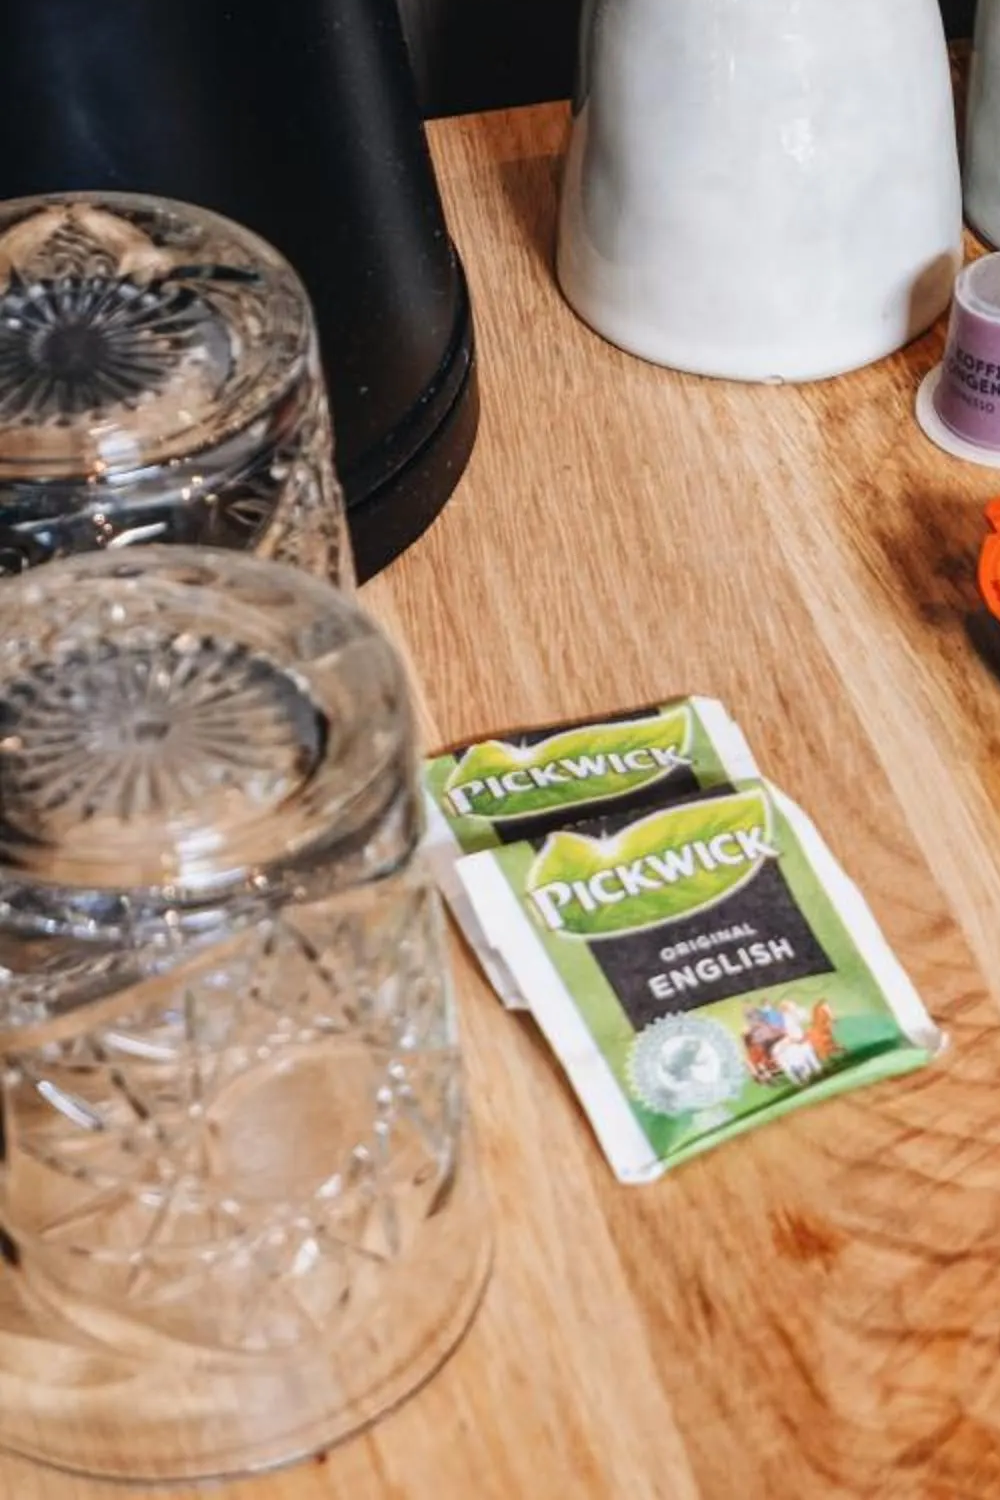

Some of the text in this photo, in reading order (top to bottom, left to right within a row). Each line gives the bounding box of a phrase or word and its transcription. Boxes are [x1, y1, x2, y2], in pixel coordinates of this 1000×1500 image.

[448, 745, 693, 816] PICKWICK
[530, 826, 780, 931] PICKWICK
[648, 937, 796, 999] ENGLISH
[659, 922, 758, 962] ORIGINAL
